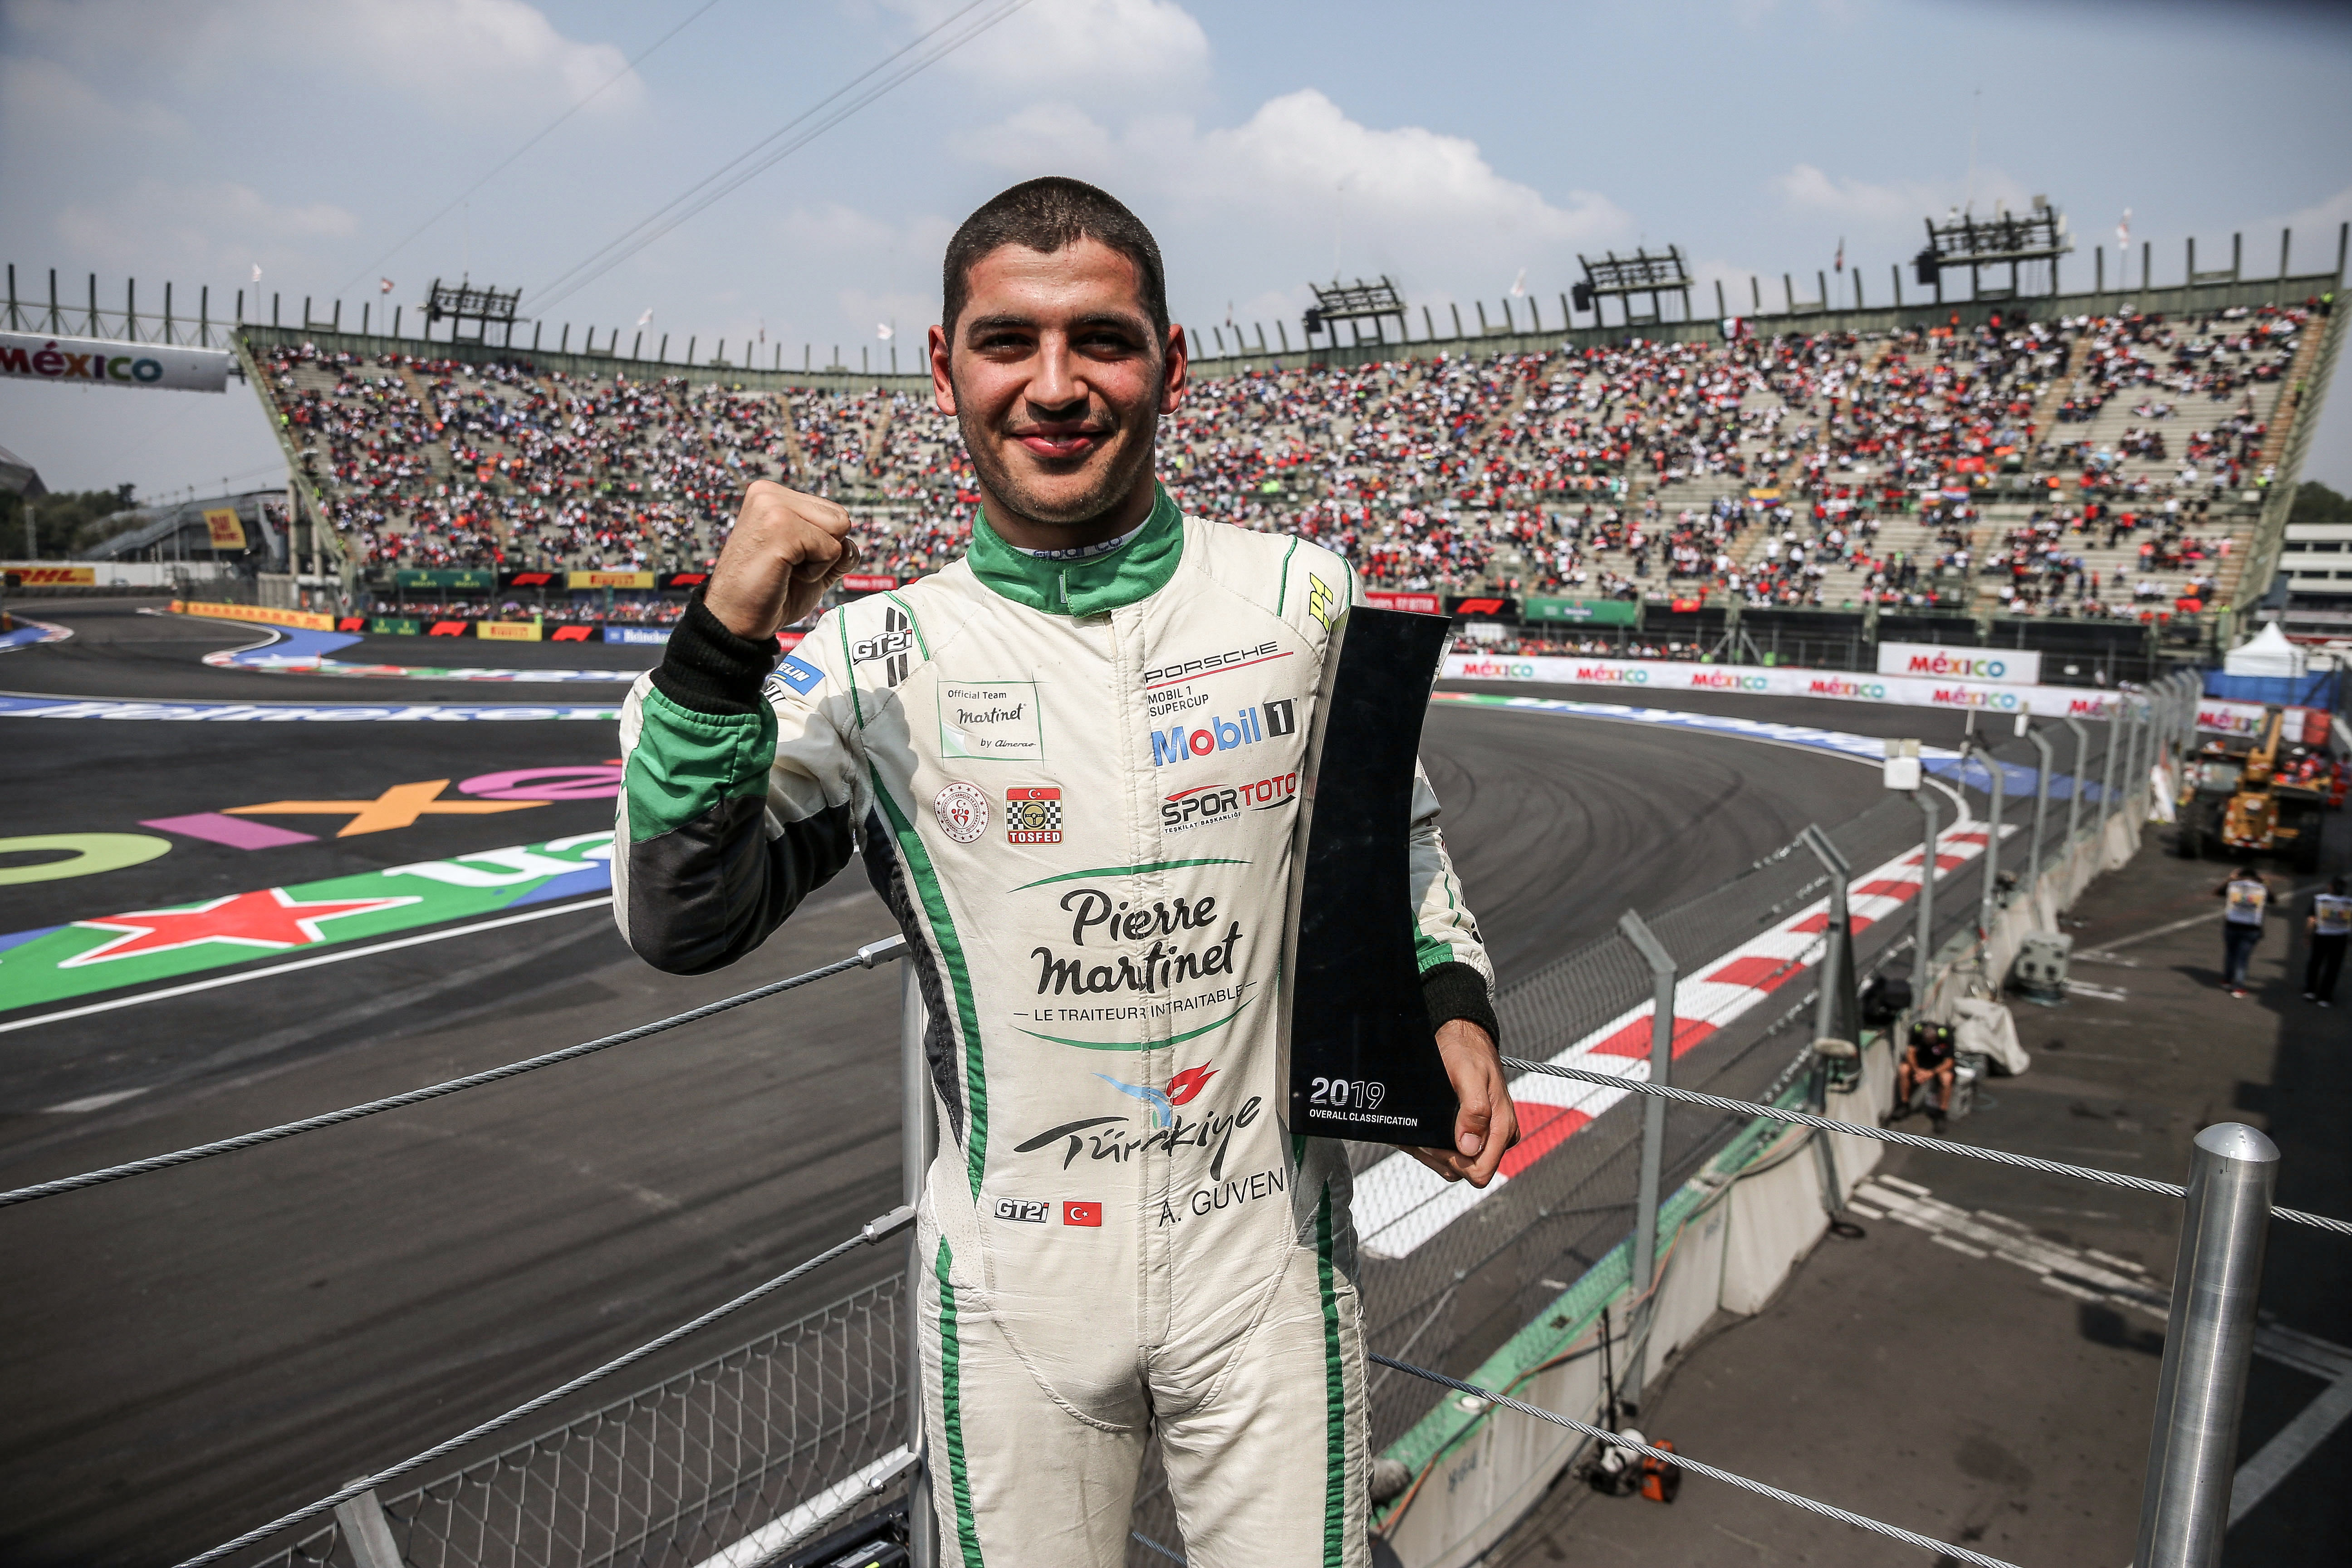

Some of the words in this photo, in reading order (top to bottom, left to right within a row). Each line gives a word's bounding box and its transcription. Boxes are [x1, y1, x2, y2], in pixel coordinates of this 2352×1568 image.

[624, 628, 670, 643] Heineke
[852, 629, 912, 661] GT2i
[1144, 641, 1278, 683] PORSCHE
[948, 690, 979, 699] Official
[1147, 688, 1183, 705] MOBIL
[1186, 686, 1191, 695] 1
[1150, 694, 1209, 717] SUPERCUP
[957, 703, 1023, 725] Martinet
[980, 739, 992, 748] by
[1151, 707, 1261, 767] Mobil
[1009, 832, 1061, 843] TOSFED
[1165, 823, 1198, 833] TEŞKİLAT
[1060, 889, 1217, 946] Pierre
[1030, 921, 1244, 995] Martinet
[1035, 1009, 1053, 1021] LE
[1151, 984, 1243, 1018] INTRAITABLE
[1310, 1077, 1385, 1109] 2019
[1309, 1109, 1348, 1120] OVERALL
[1349, 1113, 1418, 1127] CLASSIFICATION
[1014, 1096, 1261, 1181] Türkiye
[1158, 1200, 1181, 1227] A.
[1192, 1167, 1284, 1216] GUVEN
[995, 1198, 1049, 1221] GT2i
